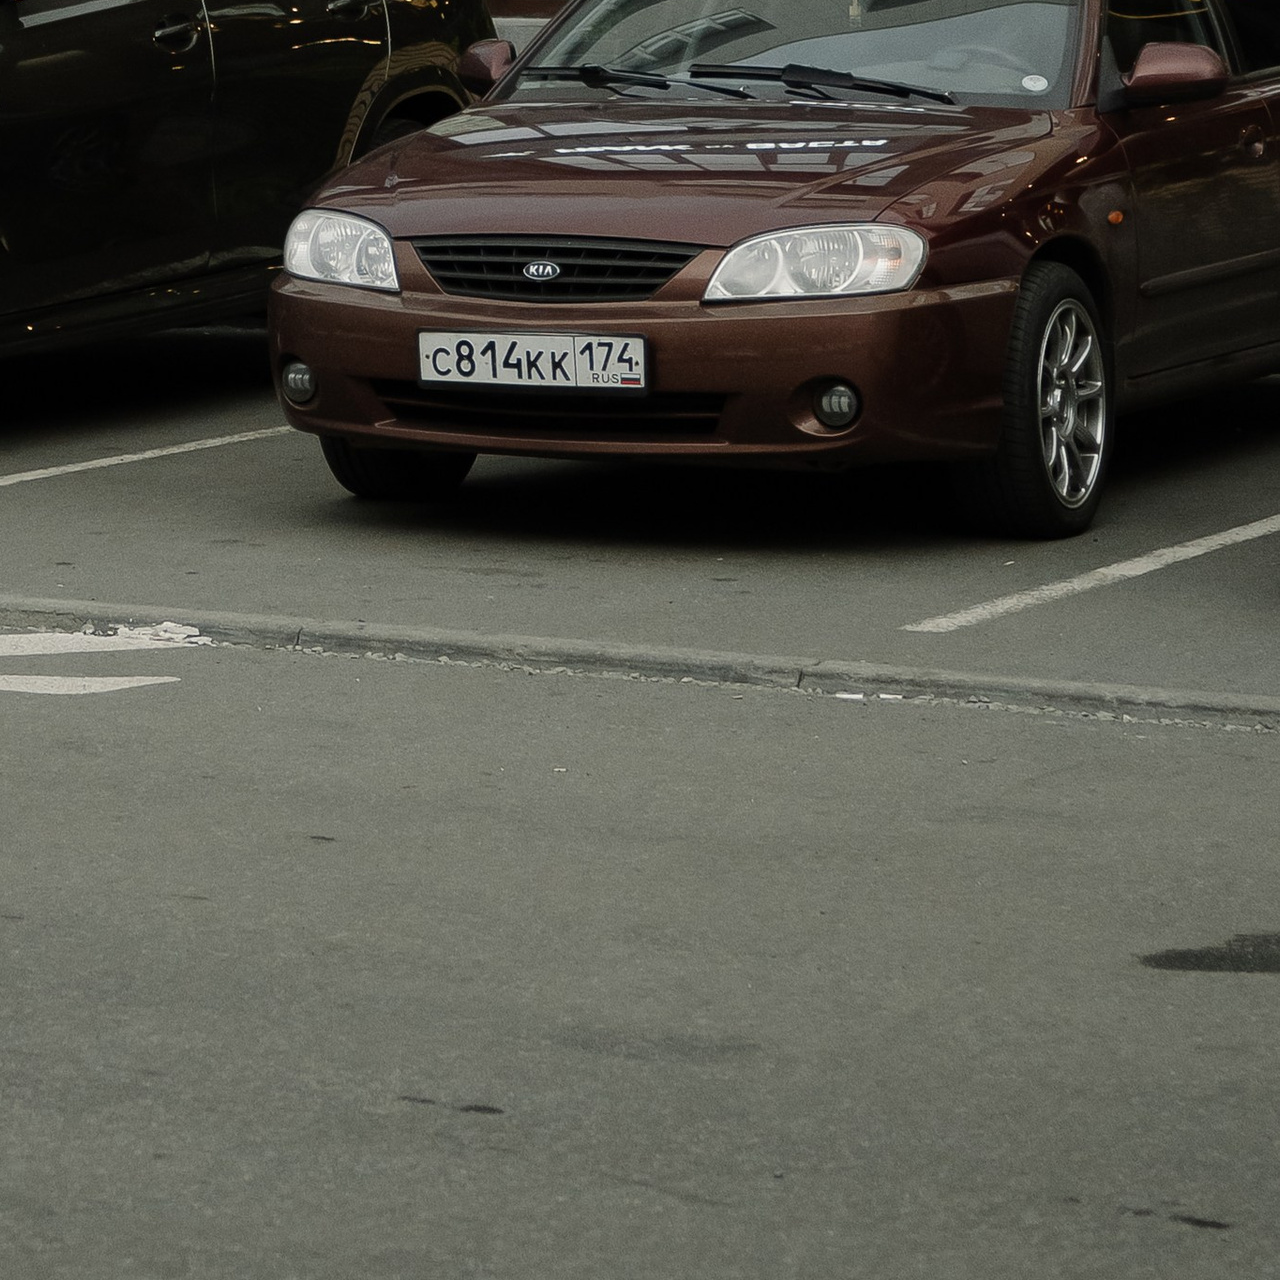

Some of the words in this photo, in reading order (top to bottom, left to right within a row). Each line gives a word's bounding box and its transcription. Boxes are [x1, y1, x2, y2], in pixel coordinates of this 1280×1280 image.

[529, 264, 553, 276] KIA
[579, 341, 634, 373] 174
[592, 372, 620, 384] RUS
